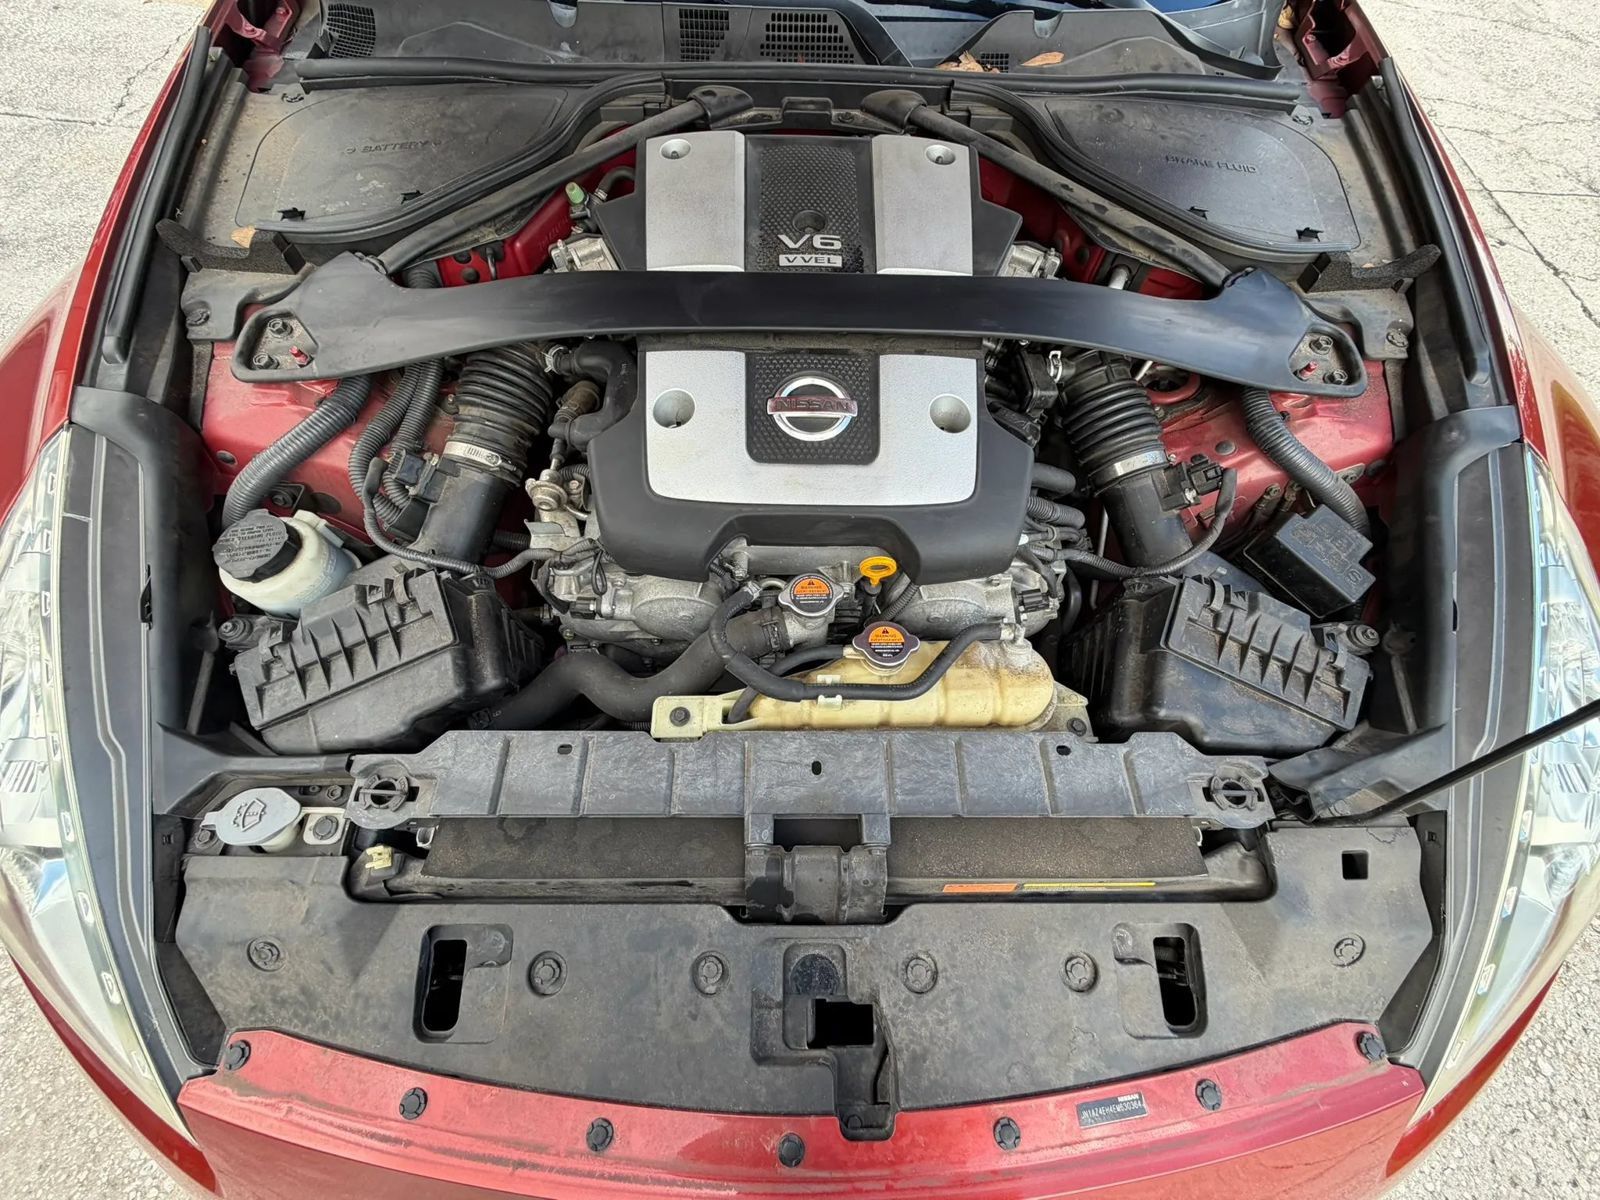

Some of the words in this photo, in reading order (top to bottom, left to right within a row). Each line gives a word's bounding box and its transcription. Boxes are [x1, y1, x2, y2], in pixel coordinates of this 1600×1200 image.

[361, 140, 429, 153] BATTERY
[1217, 160, 1257, 173] FLUID
[777, 234, 842, 250] V6
[784, 256, 838, 265] VVEL
[776, 398, 849, 411] NISSAN
